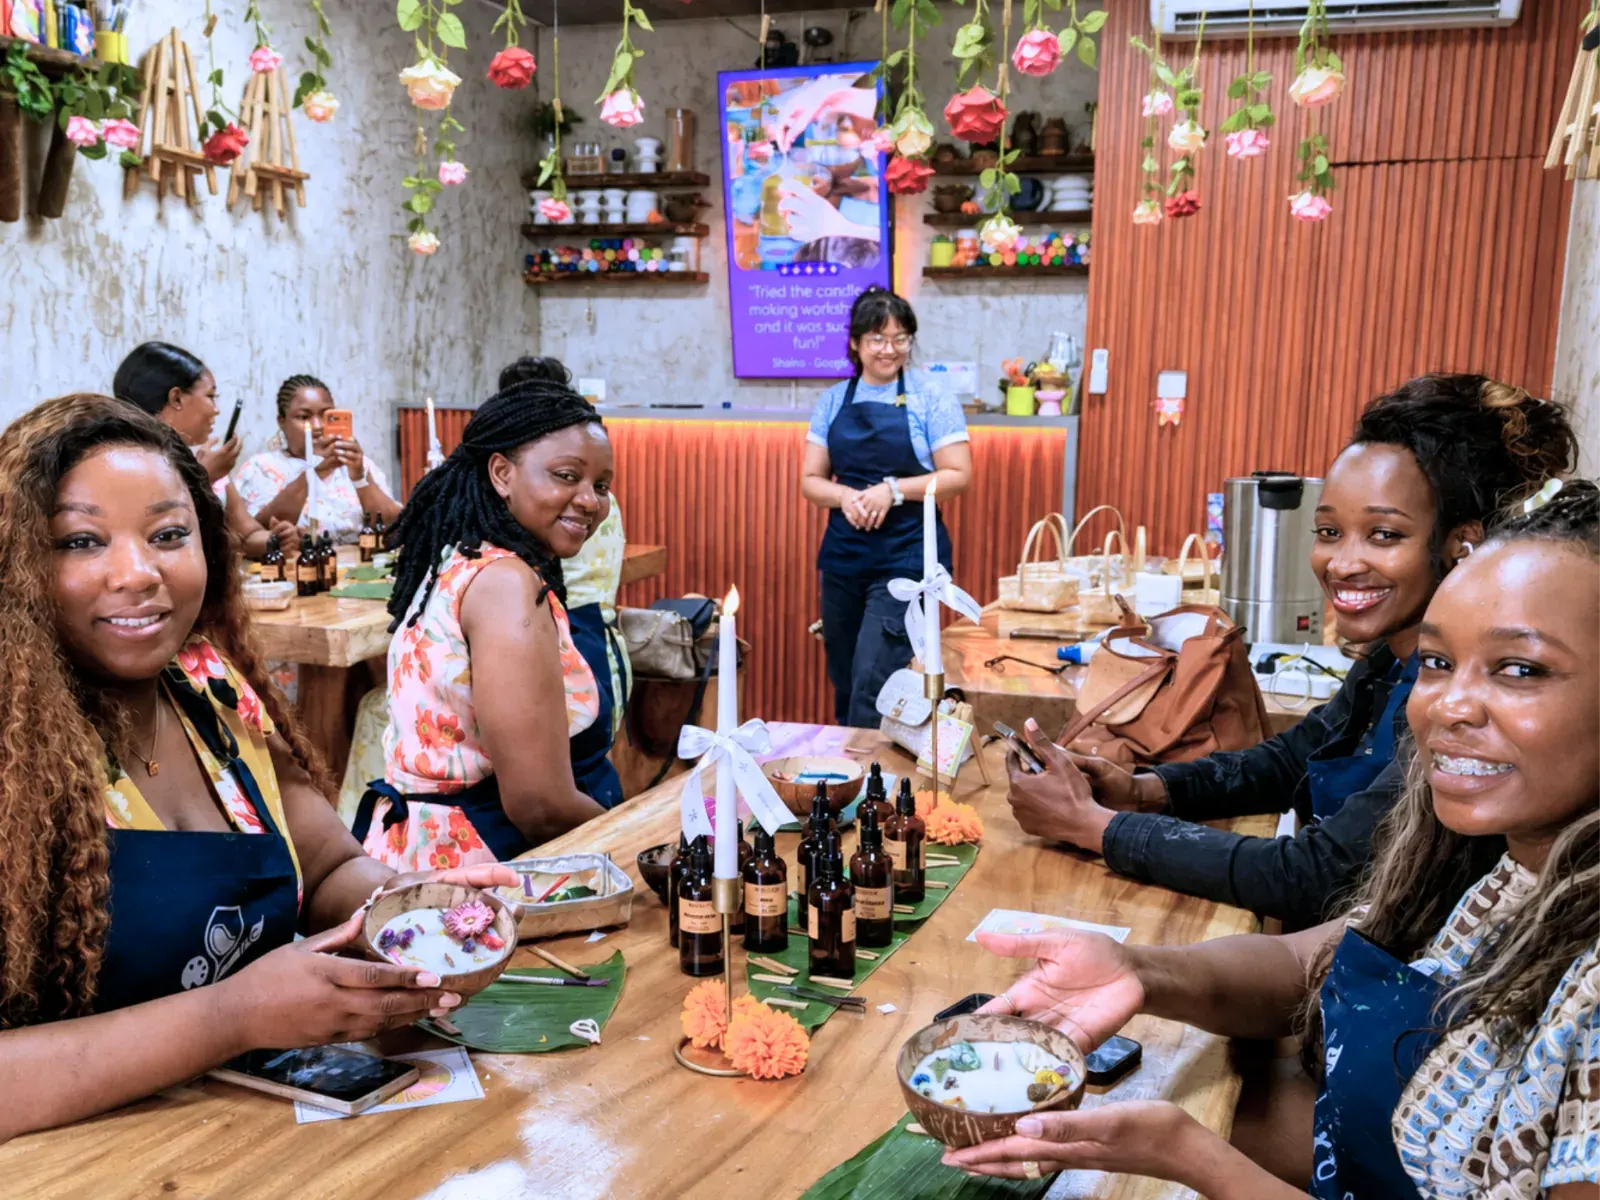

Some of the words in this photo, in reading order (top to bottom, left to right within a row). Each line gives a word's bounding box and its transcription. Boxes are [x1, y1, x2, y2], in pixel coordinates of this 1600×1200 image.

[791, 284, 813, 298] the
[749, 303, 798, 318] making
[801, 302, 852, 316] worksh
[754, 320, 781, 333] and
[784, 320, 793, 333] it
[796, 322, 823, 333] was
[826, 322, 849, 333] suc
[814, 357, 849, 371] Google
